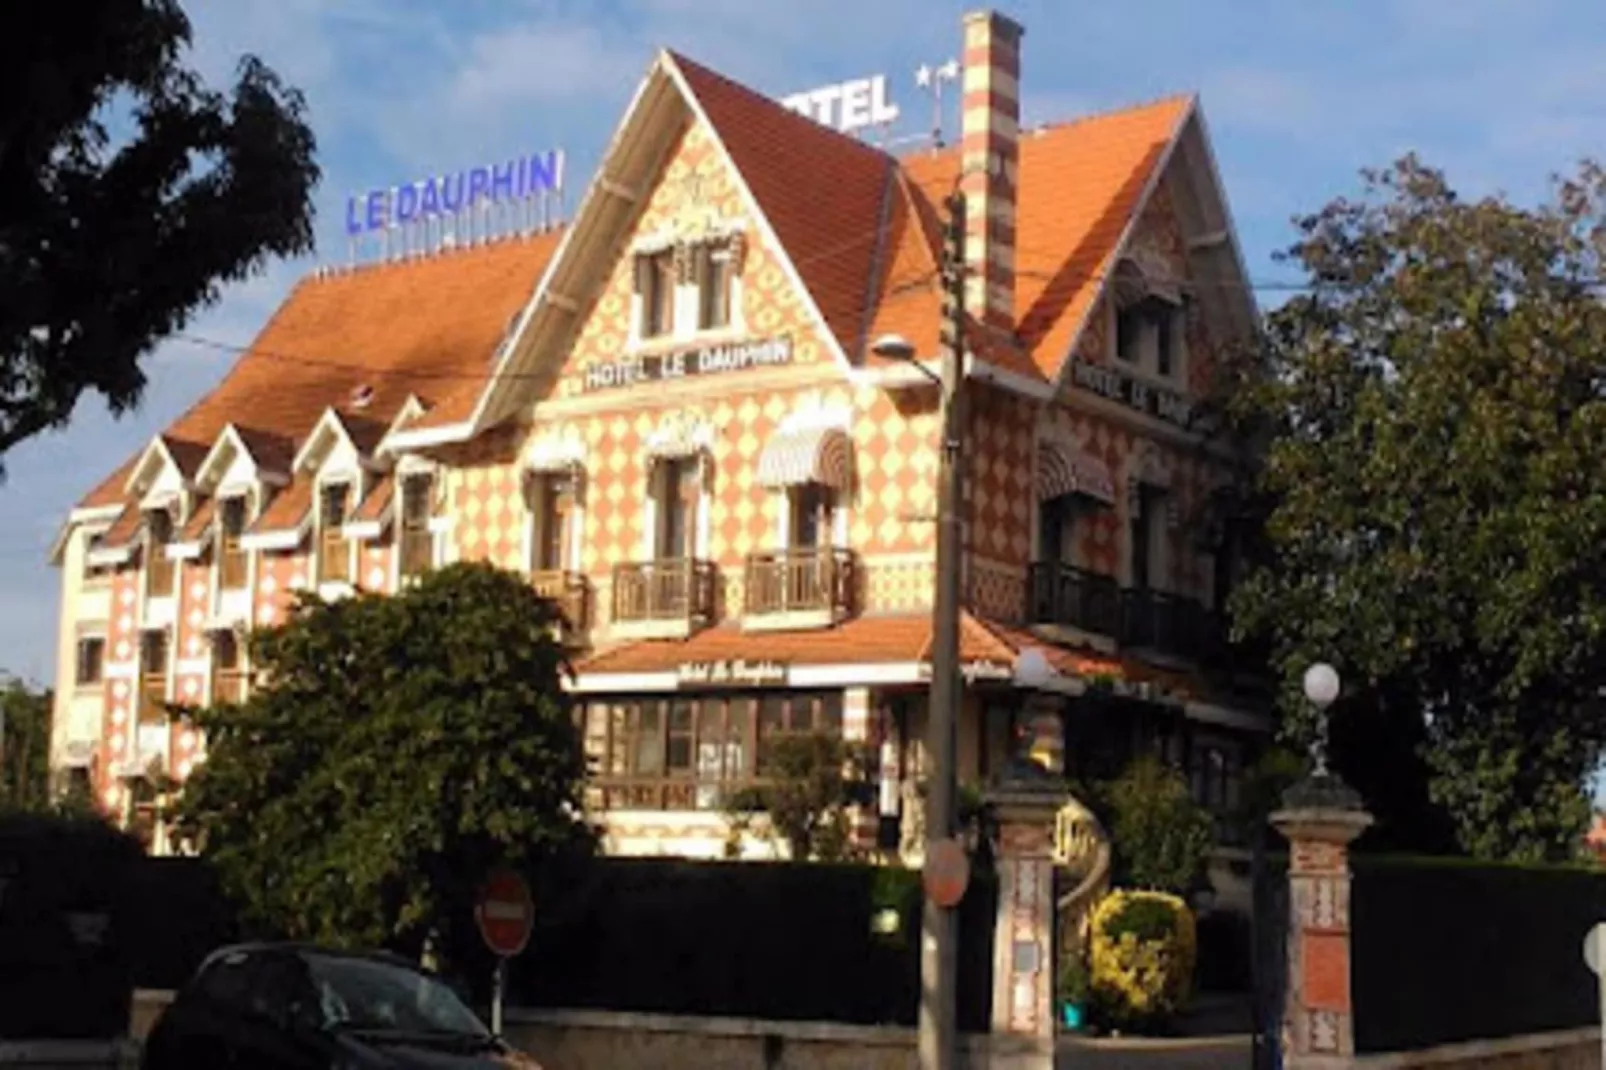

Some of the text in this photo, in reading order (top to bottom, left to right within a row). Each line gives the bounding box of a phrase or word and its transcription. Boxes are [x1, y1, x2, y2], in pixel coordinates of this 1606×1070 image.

[346, 150, 562, 235] LE DAUPHIN
[586, 340, 789, 388] HOTEL LE DAUPHIN
